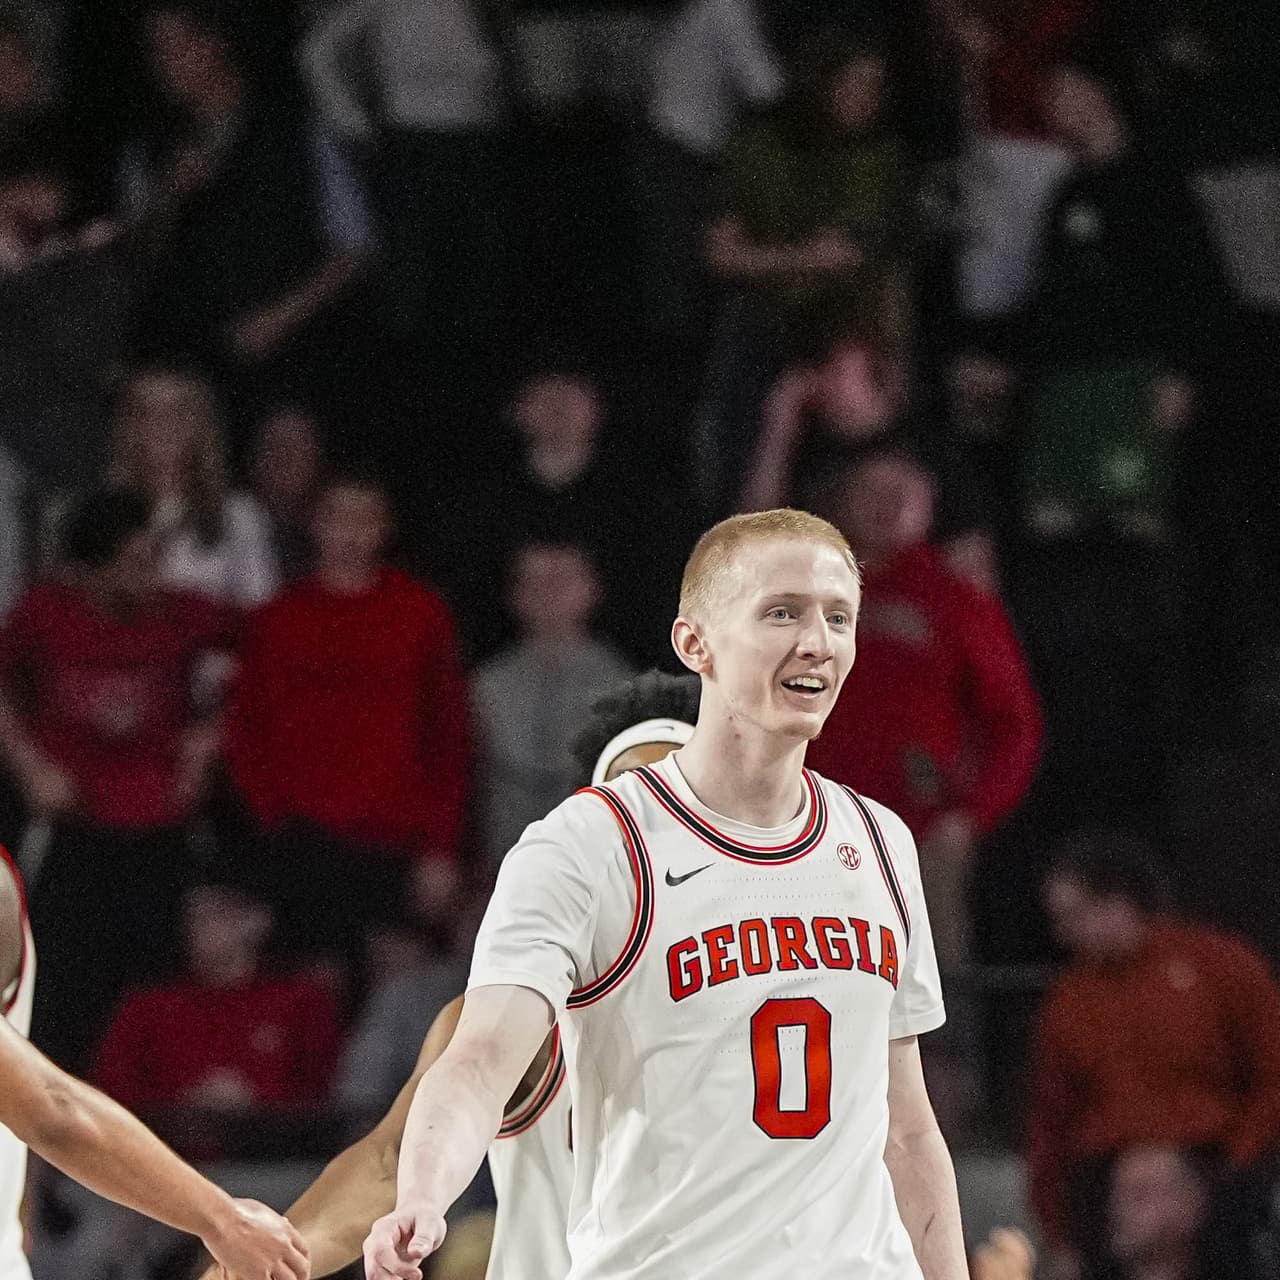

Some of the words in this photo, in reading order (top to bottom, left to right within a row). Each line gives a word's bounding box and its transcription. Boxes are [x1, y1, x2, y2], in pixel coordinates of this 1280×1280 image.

[839, 845, 860, 868] SEC
[666, 916, 899, 1003] GEORGIA
[750, 997, 832, 1139] 0
